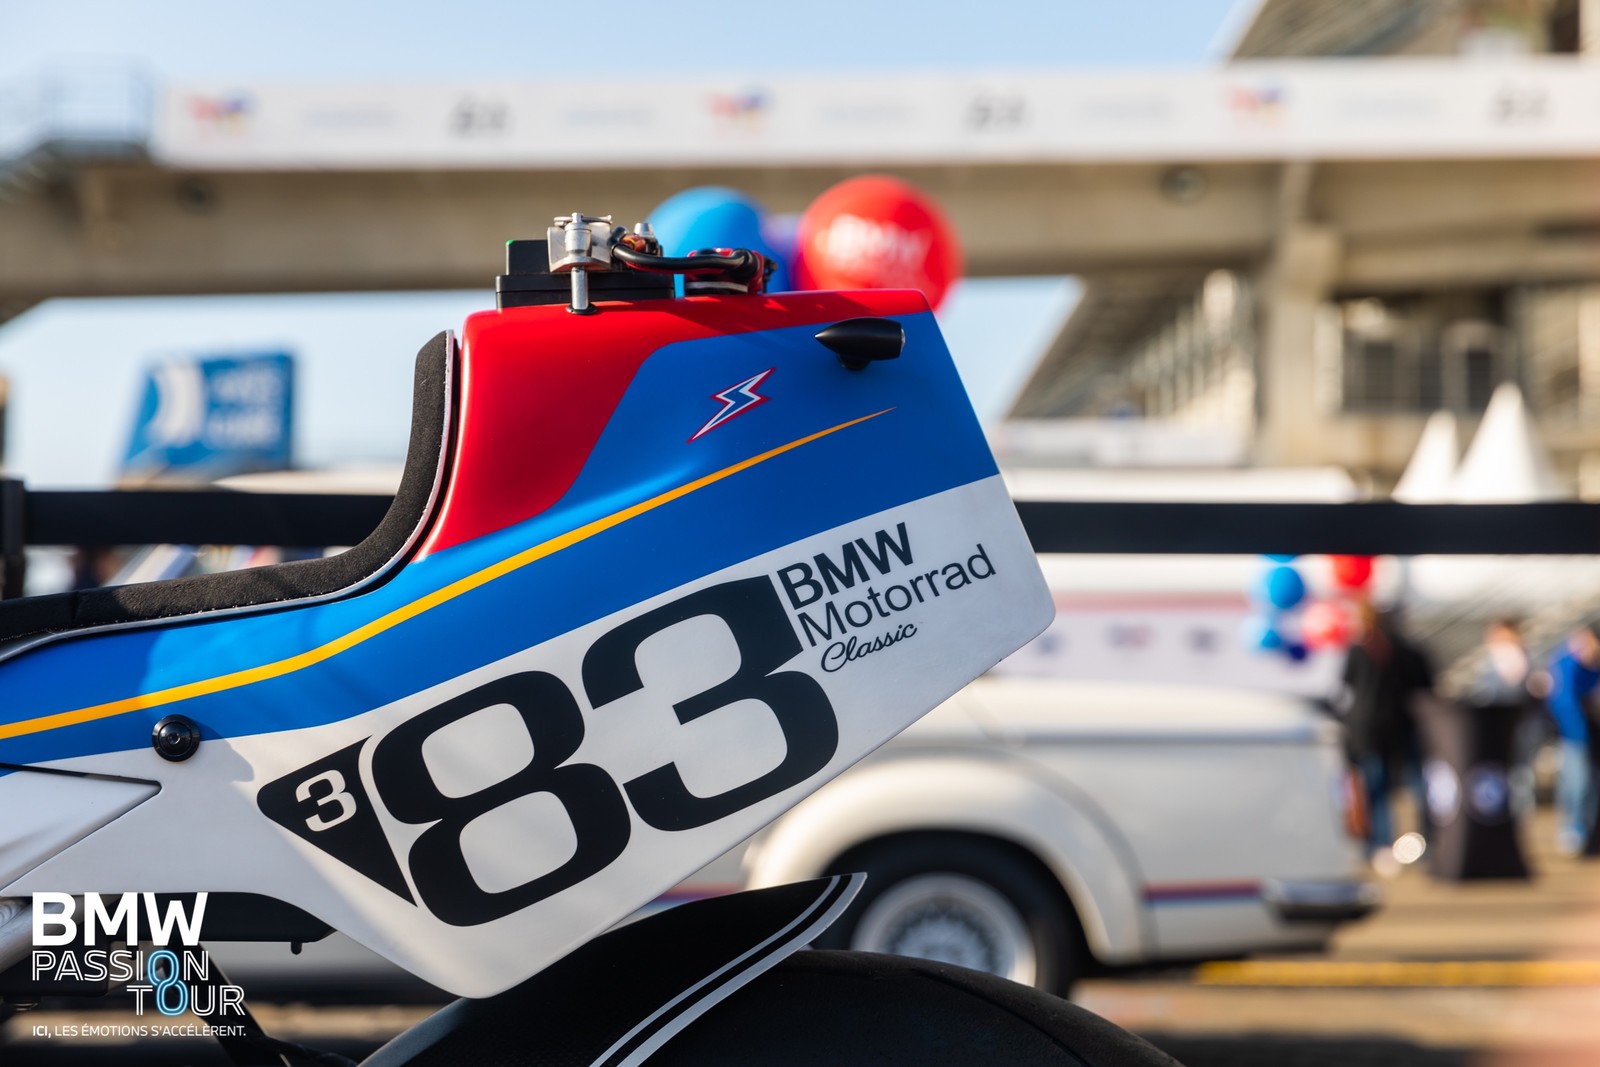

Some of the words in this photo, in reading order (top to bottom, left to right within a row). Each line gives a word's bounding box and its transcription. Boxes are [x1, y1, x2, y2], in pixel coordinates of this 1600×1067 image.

[818, 214, 931, 272] BMW
[777, 522, 914, 610] BMW
[797, 543, 996, 647] Motorrad
[820, 623, 918, 673] Classic
[371, 574, 839, 927] 83
[295, 769, 358, 833] 3
